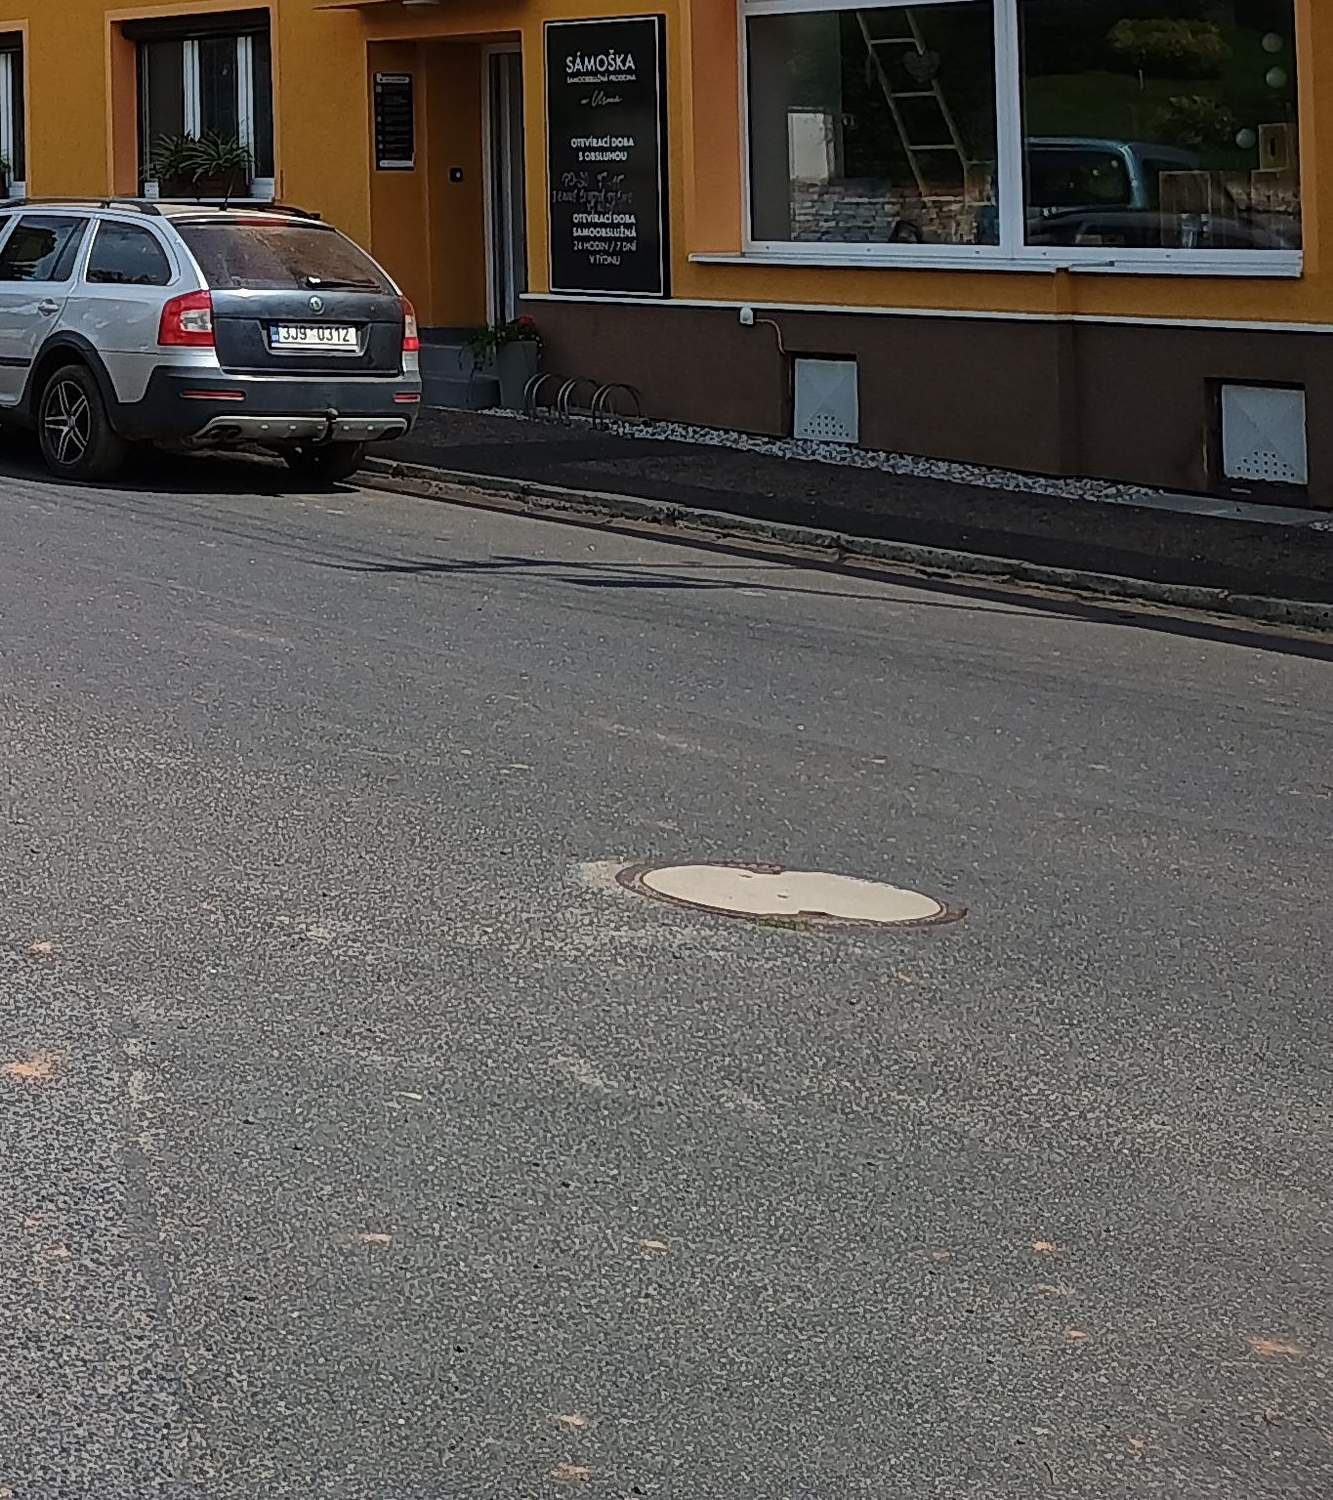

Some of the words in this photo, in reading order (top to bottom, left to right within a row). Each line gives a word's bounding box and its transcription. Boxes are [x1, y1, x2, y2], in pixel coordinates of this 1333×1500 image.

[566, 49, 635, 73] SÁMOŠKA
[611, 137, 634, 148] DOBA
[584, 151, 627, 161] OBSLUHOU
[613, 213, 636, 224] DOBA
[573, 225, 637, 237] SAMOOBSLUŽNÁ
[573, 241, 583, 251] 24
[583, 241, 609, 251] HODIN
[616, 241, 621, 251] 7
[589, 254, 595, 264] V
[595, 253, 621, 265] TÝDNU
[283, 325, 307, 341] 3J9
[317, 326, 350, 342] 0312
